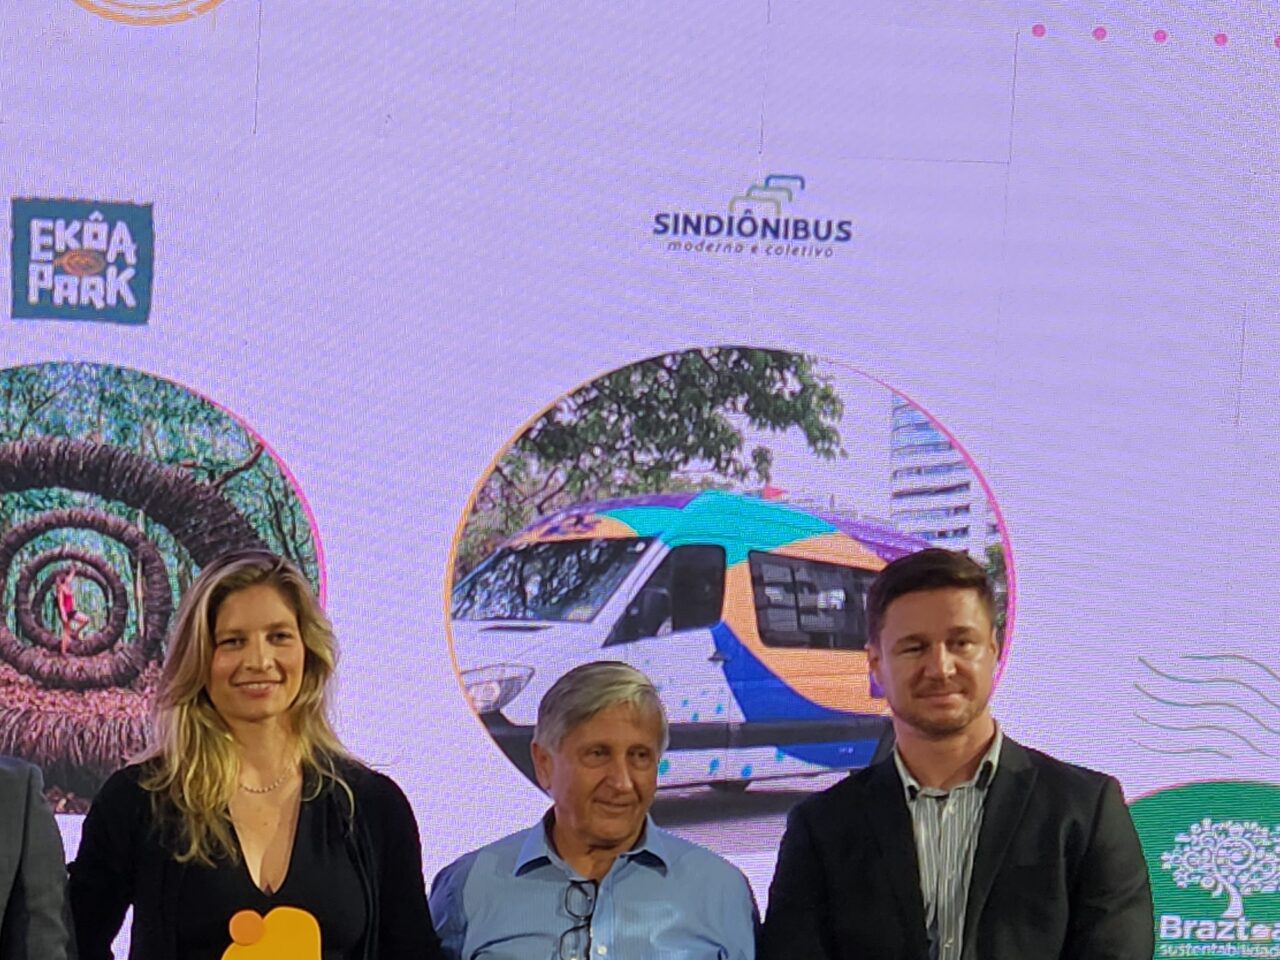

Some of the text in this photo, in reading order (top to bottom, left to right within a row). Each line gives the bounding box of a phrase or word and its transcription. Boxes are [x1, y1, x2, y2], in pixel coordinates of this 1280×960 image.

[653, 209, 852, 242] SINDIÔNIBUS
[668, 240, 744, 254] moderno
[765, 243, 834, 259] coletivo
[28, 263, 137, 310] PARK
